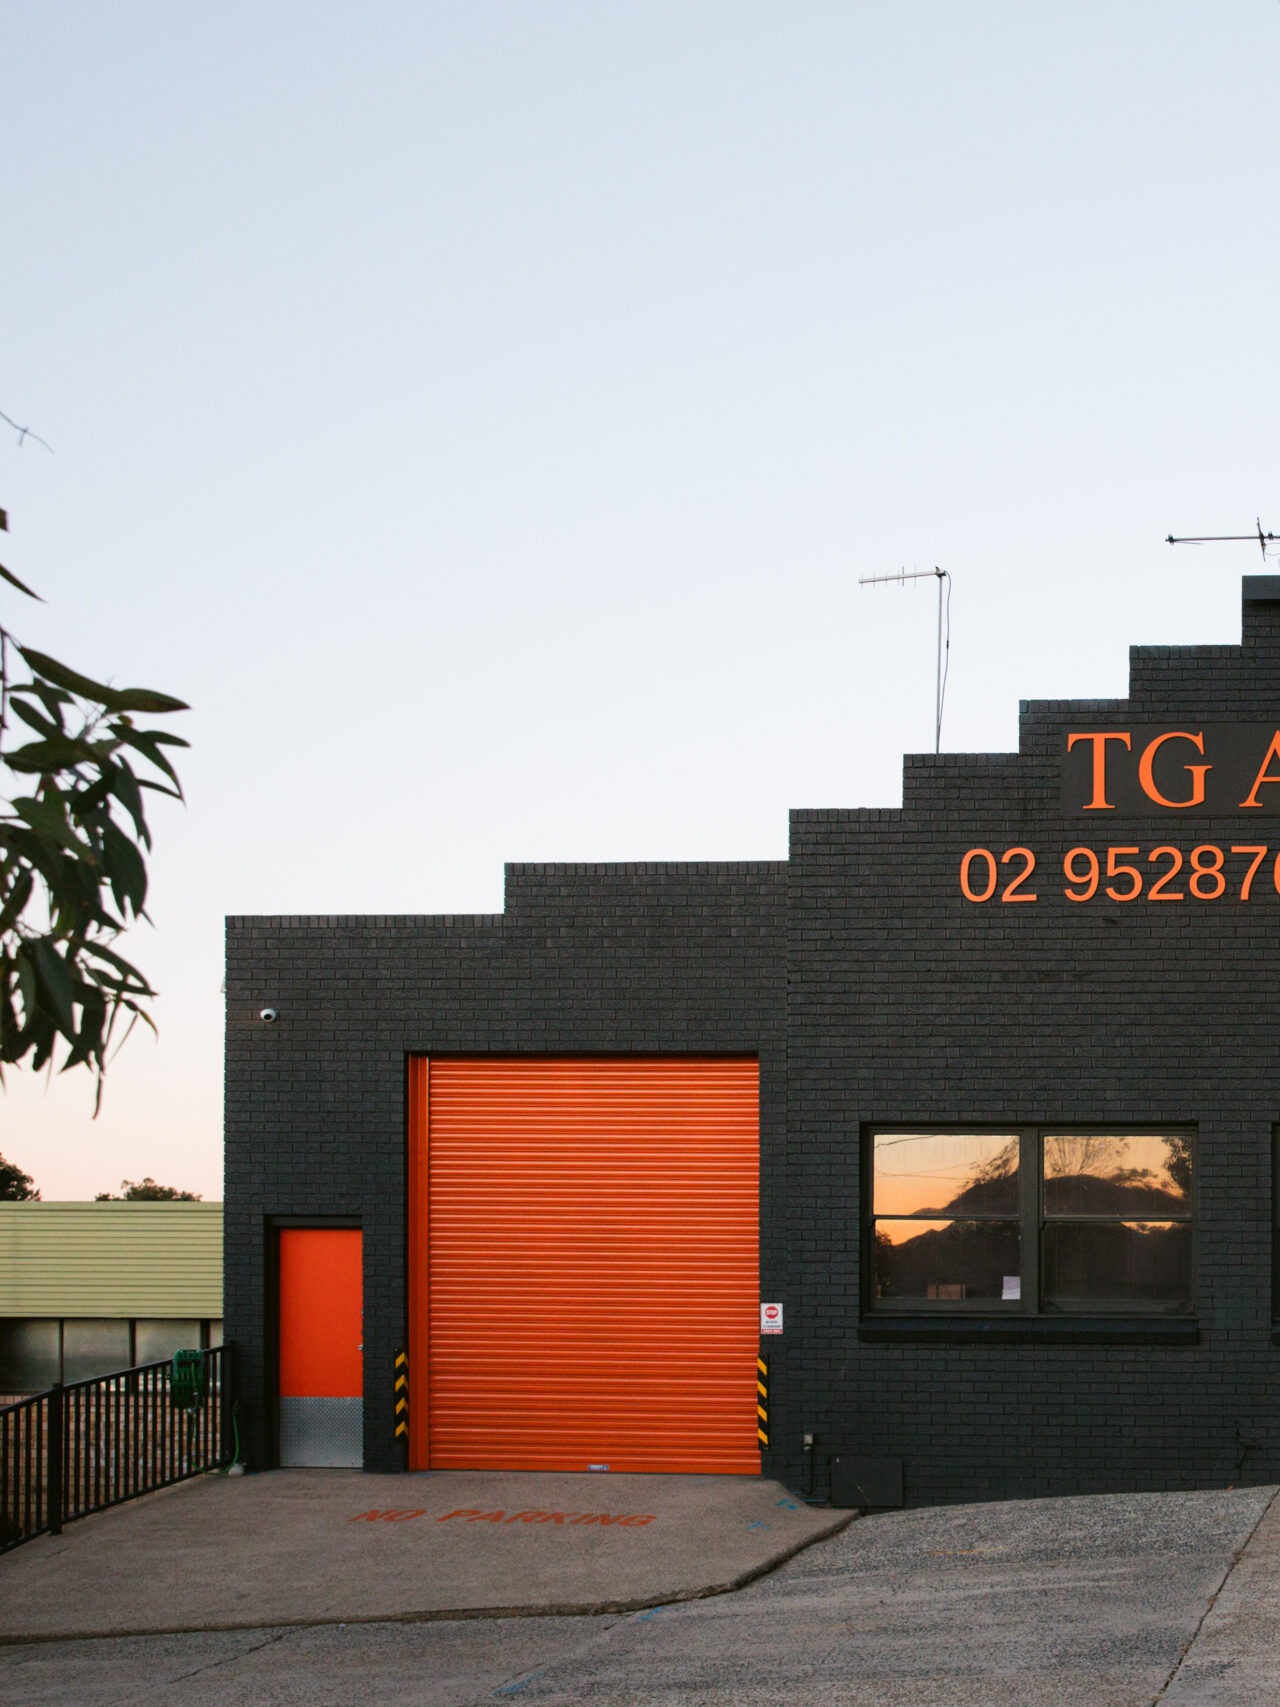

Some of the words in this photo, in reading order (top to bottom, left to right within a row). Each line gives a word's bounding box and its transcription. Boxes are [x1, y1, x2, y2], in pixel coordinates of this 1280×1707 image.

[1067, 731, 1213, 809] TG
[960, 847, 1037, 902] 02
[347, 1509, 427, 1522] NO
[436, 1509, 657, 1527] PARKING
